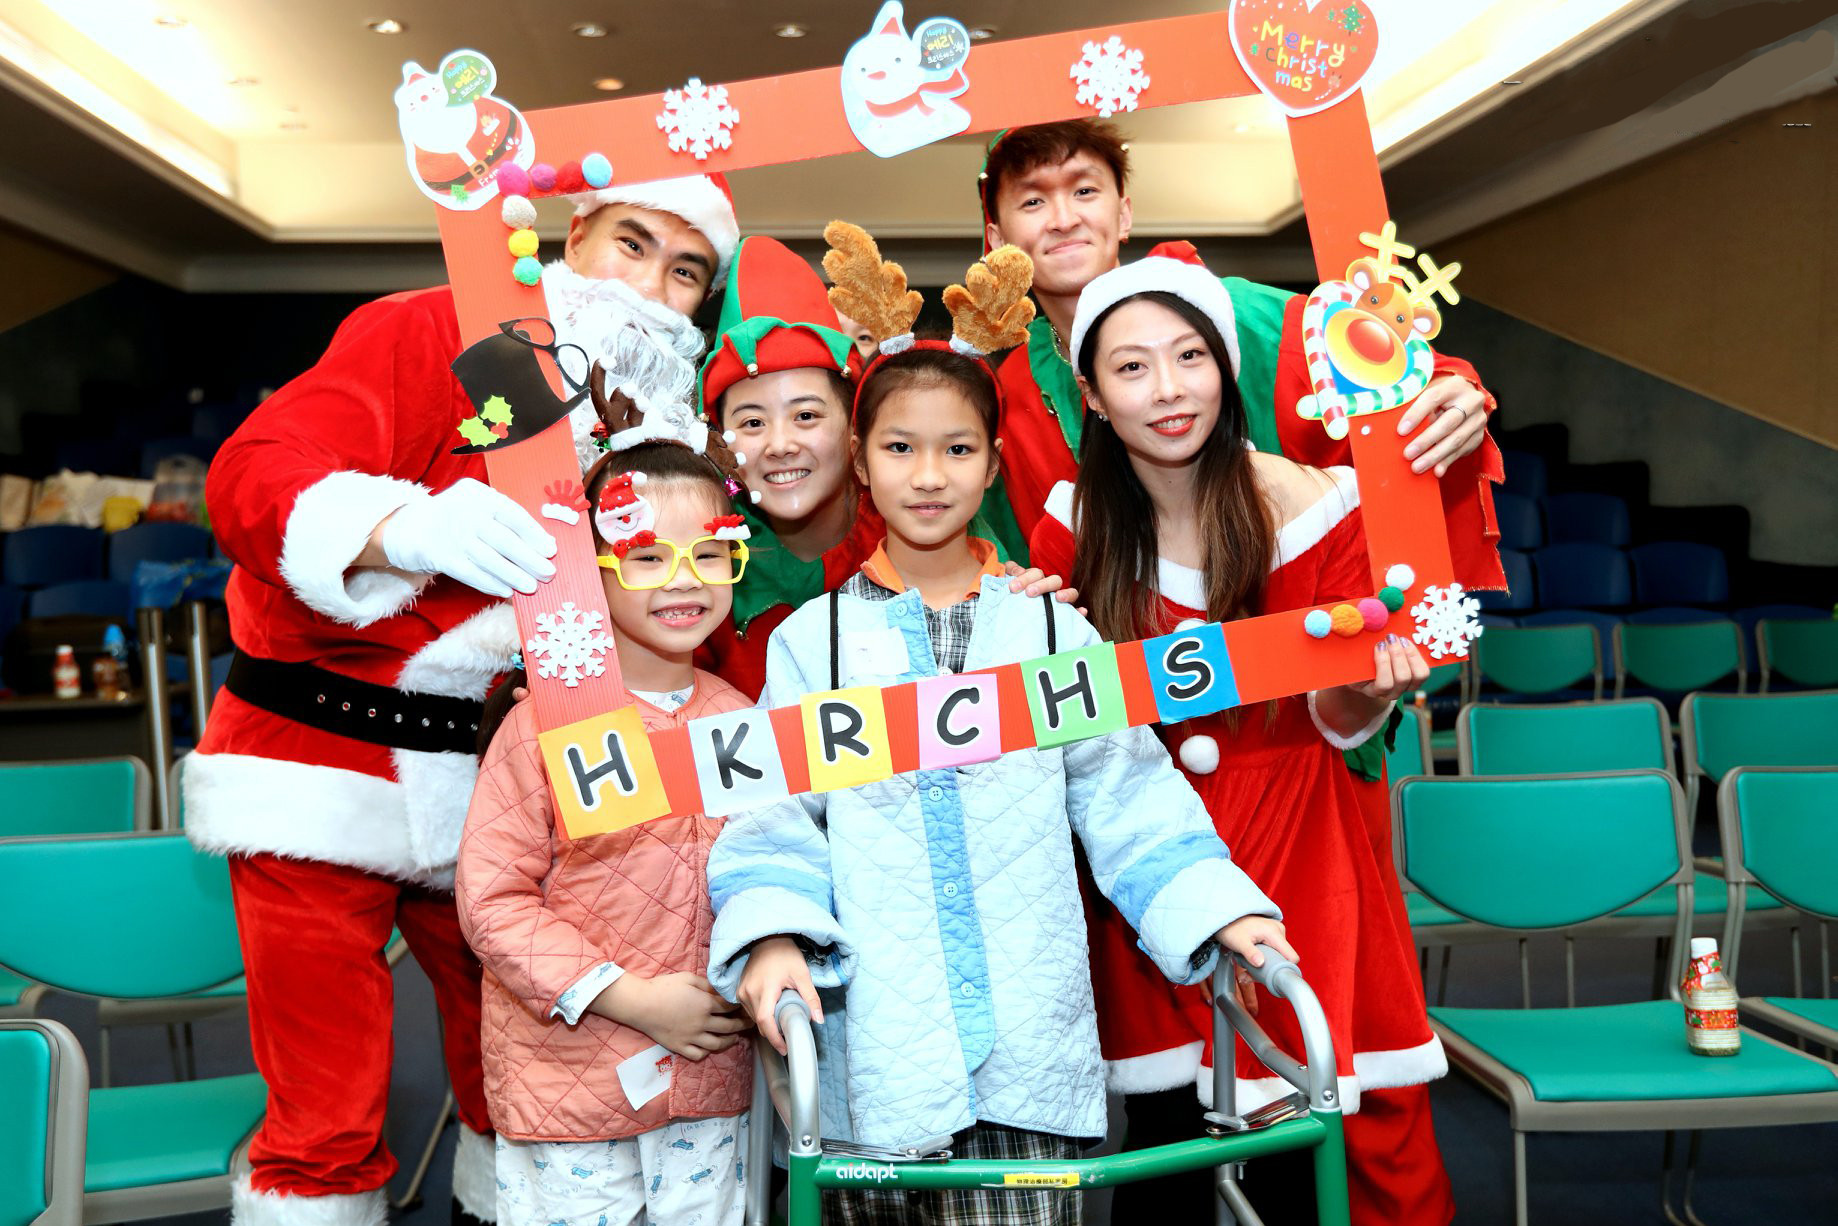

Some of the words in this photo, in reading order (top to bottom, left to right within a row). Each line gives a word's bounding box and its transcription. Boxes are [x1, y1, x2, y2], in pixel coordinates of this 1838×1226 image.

[1260, 20, 1345, 68] Merry
[1275, 70, 1313, 92] mas
[836, 1162, 899, 1184] aidapt
